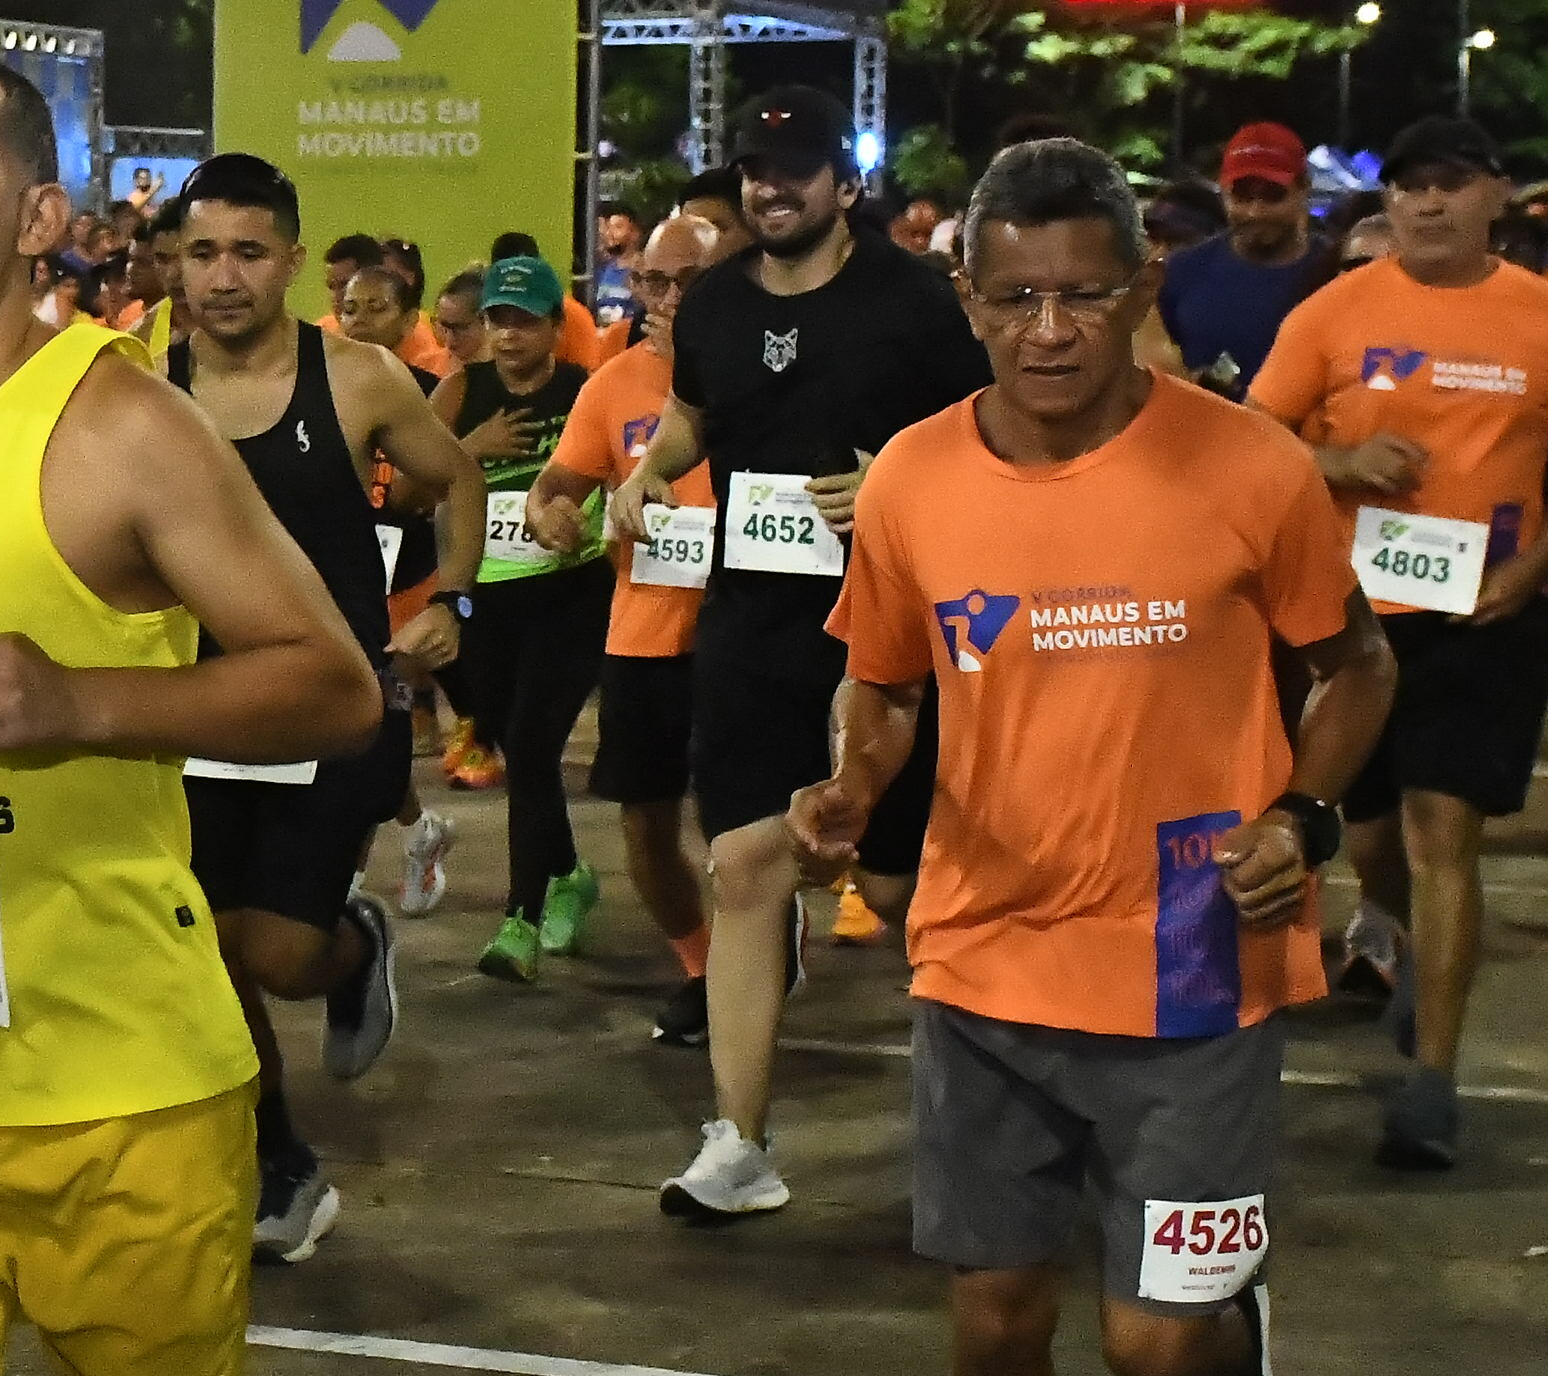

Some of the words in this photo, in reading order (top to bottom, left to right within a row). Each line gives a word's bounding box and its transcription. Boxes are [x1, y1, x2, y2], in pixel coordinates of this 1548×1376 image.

[299, 100, 428, 125] MANAUS
[438, 98, 481, 125] EM
[298, 131, 481, 157] MOVIMENTO
[743, 513, 815, 545] 4652
[648, 537, 704, 564] 4593
[1371, 546, 1450, 583] 4803
[1030, 601, 1141, 629] MANAUS
[1147, 599, 1187, 621] EM
[1031, 623, 1189, 652] MOVIMENTO
[1152, 1204, 1263, 1256] 4526
